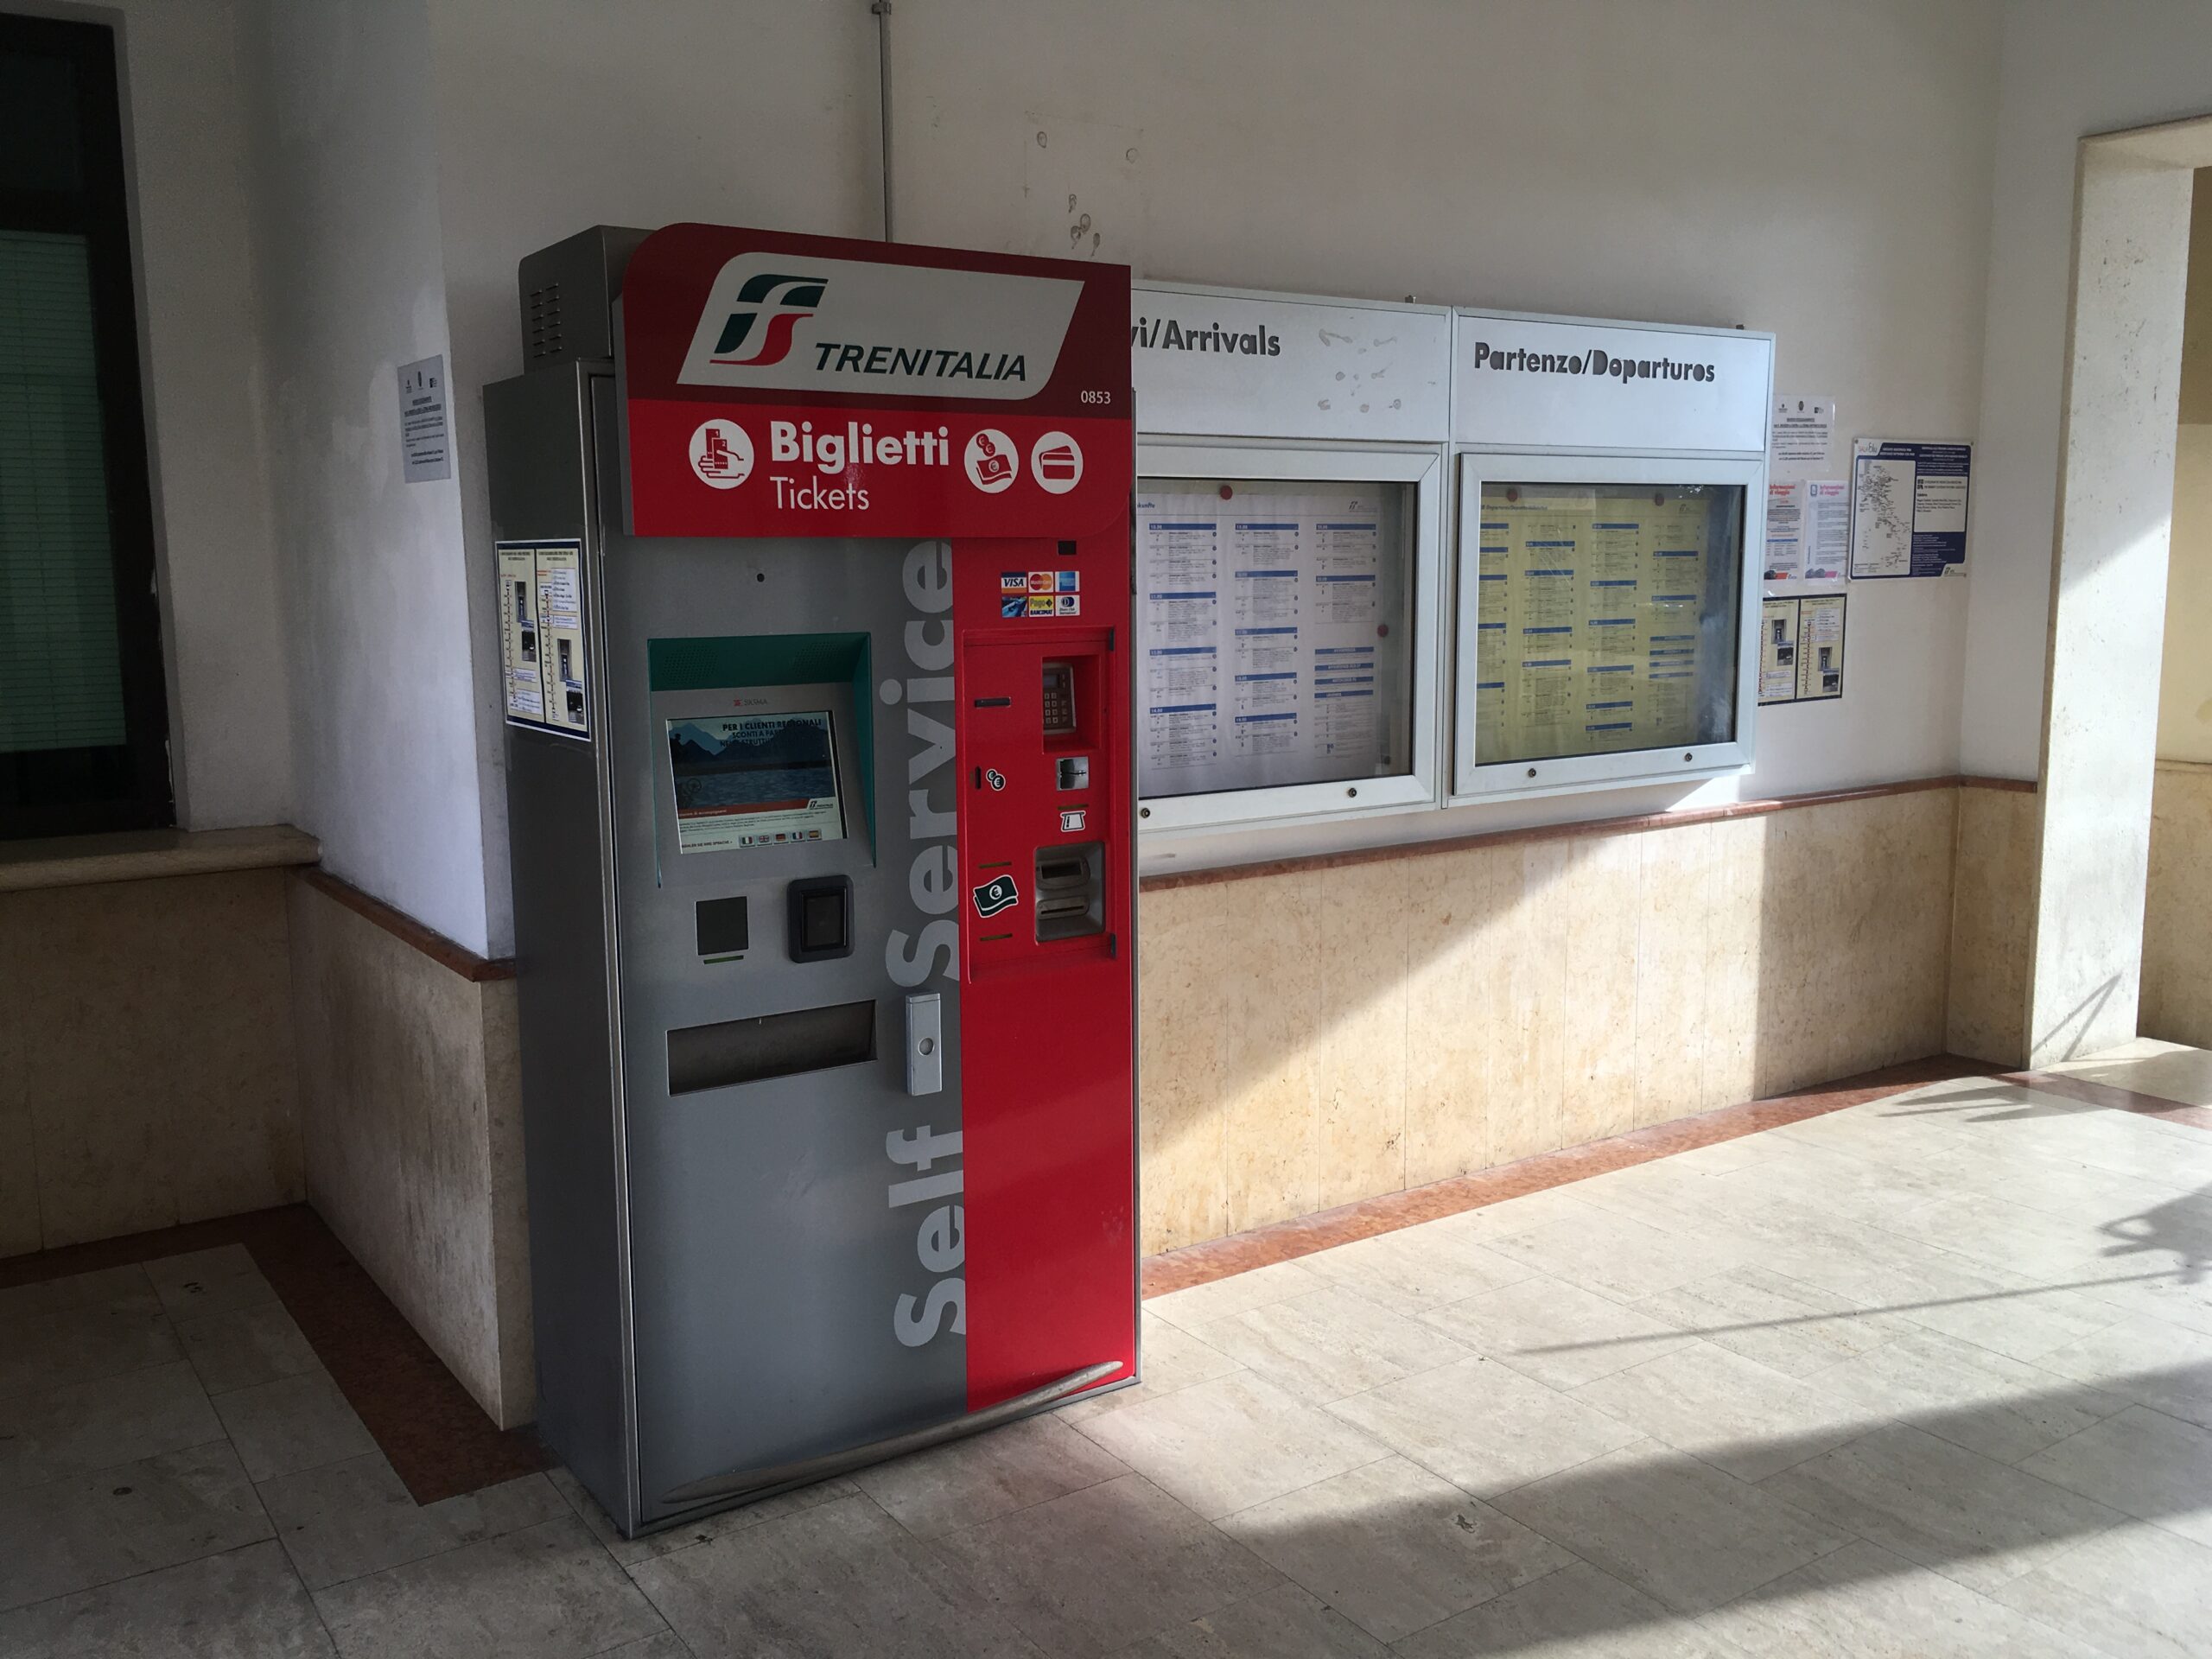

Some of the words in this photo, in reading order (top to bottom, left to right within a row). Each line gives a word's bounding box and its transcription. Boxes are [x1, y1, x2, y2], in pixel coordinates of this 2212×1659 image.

[815, 342, 1027, 381] TRENITALIA
[1080, 391, 1111, 404] 0853
[771, 421, 949, 474] Biglietti
[770, 476, 869, 510] Tickets
[1004, 578, 1024, 587] VISA
[722, 723, 739, 732] PER
[744, 721, 776, 730] CLIENTI
[879, 541, 961, 987] Service
[886, 1125, 967, 1347] Self
